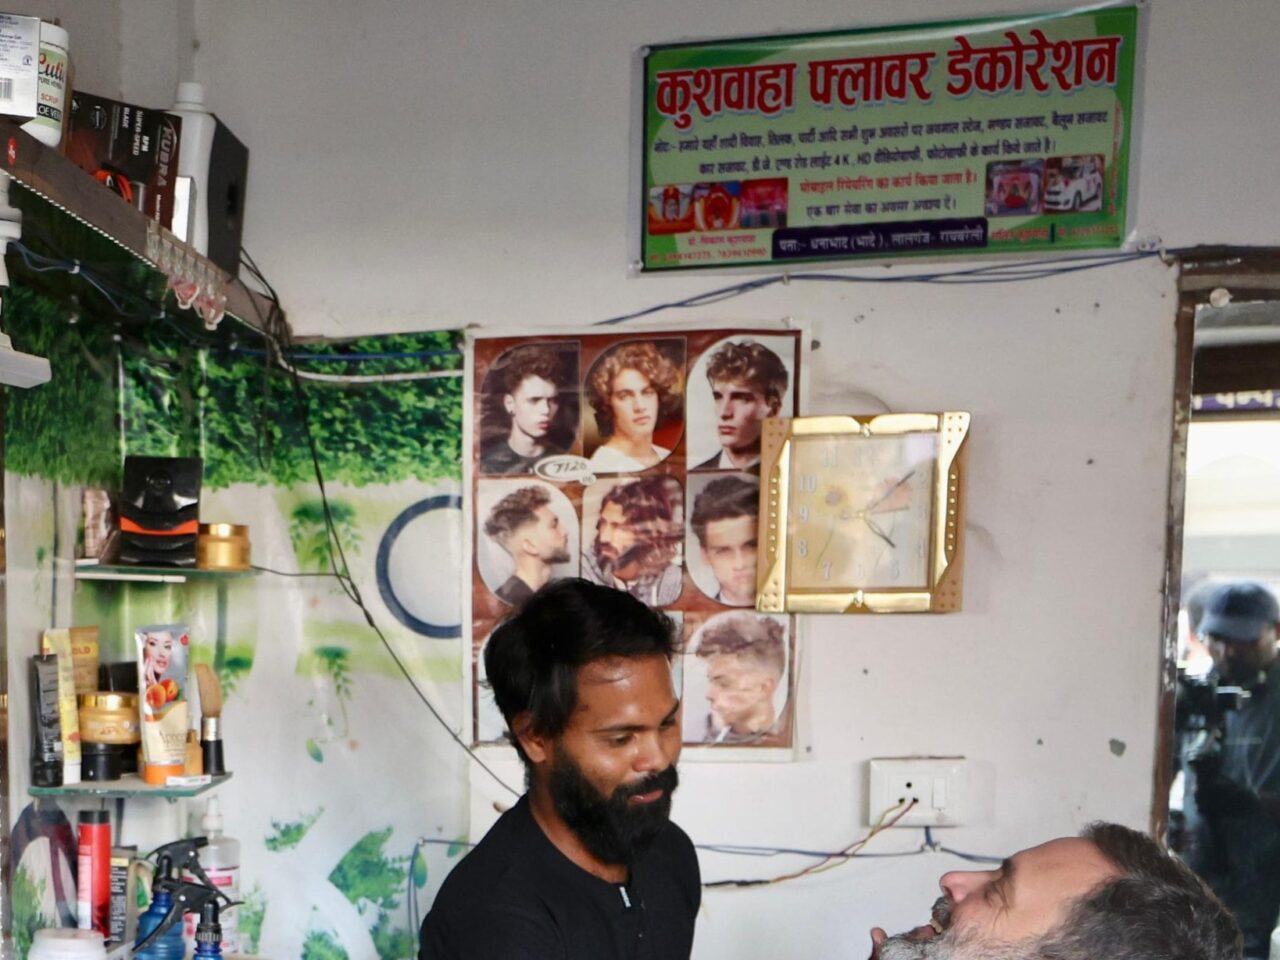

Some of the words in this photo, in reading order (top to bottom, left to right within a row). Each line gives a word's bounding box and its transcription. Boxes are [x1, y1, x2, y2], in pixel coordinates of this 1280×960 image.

[656, 62, 797, 129] कुशवाहा
[808, 52, 936, 105] फ्लावर
[946, 29, 1120, 95] डेकोरेशन
[876, 177, 889, 189] का
[806, 206, 823, 221] एक
[825, 204, 840, 217] बार
[843, 200, 862, 215] सेवा
[864, 202, 878, 214] का
[880, 200, 909, 214] अवसर
[799, 474, 817, 493] 10
[799, 504, 810, 522] 9
[798, 541, 809, 559] 8
[822, 560, 833, 580] 7
